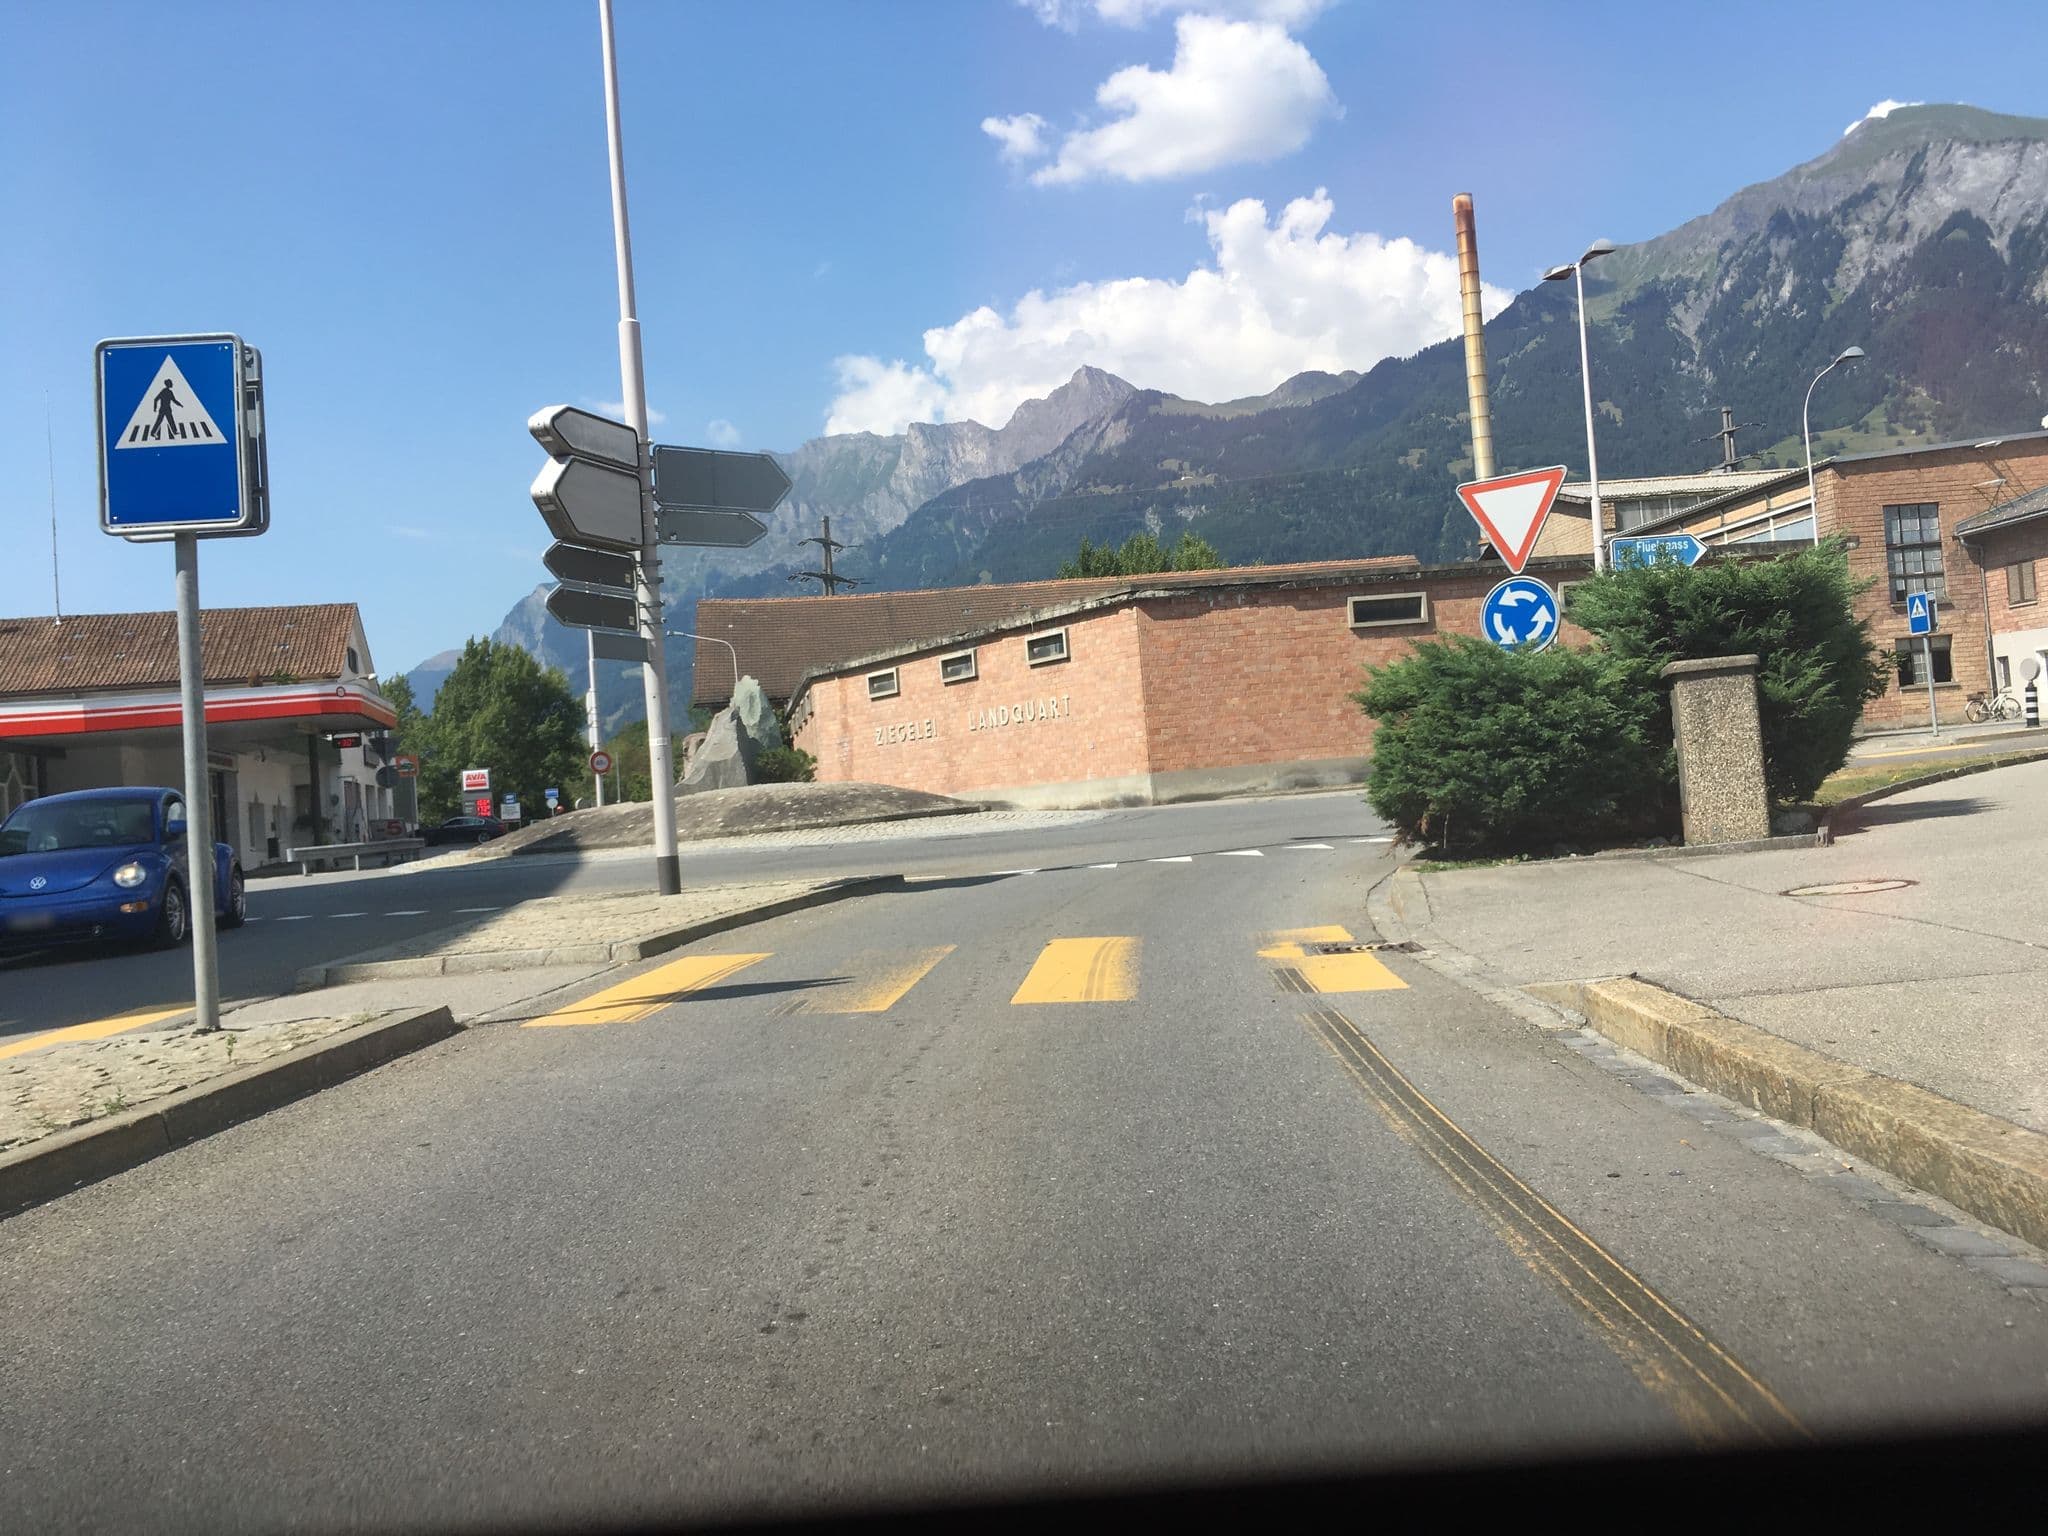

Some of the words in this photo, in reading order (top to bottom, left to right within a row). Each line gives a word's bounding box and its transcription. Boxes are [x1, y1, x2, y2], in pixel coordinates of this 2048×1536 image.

[875, 718, 938, 746] ZIEGELEI
[968, 695, 1071, 731] LANDQUART
[465, 773, 487, 781] AVIA
